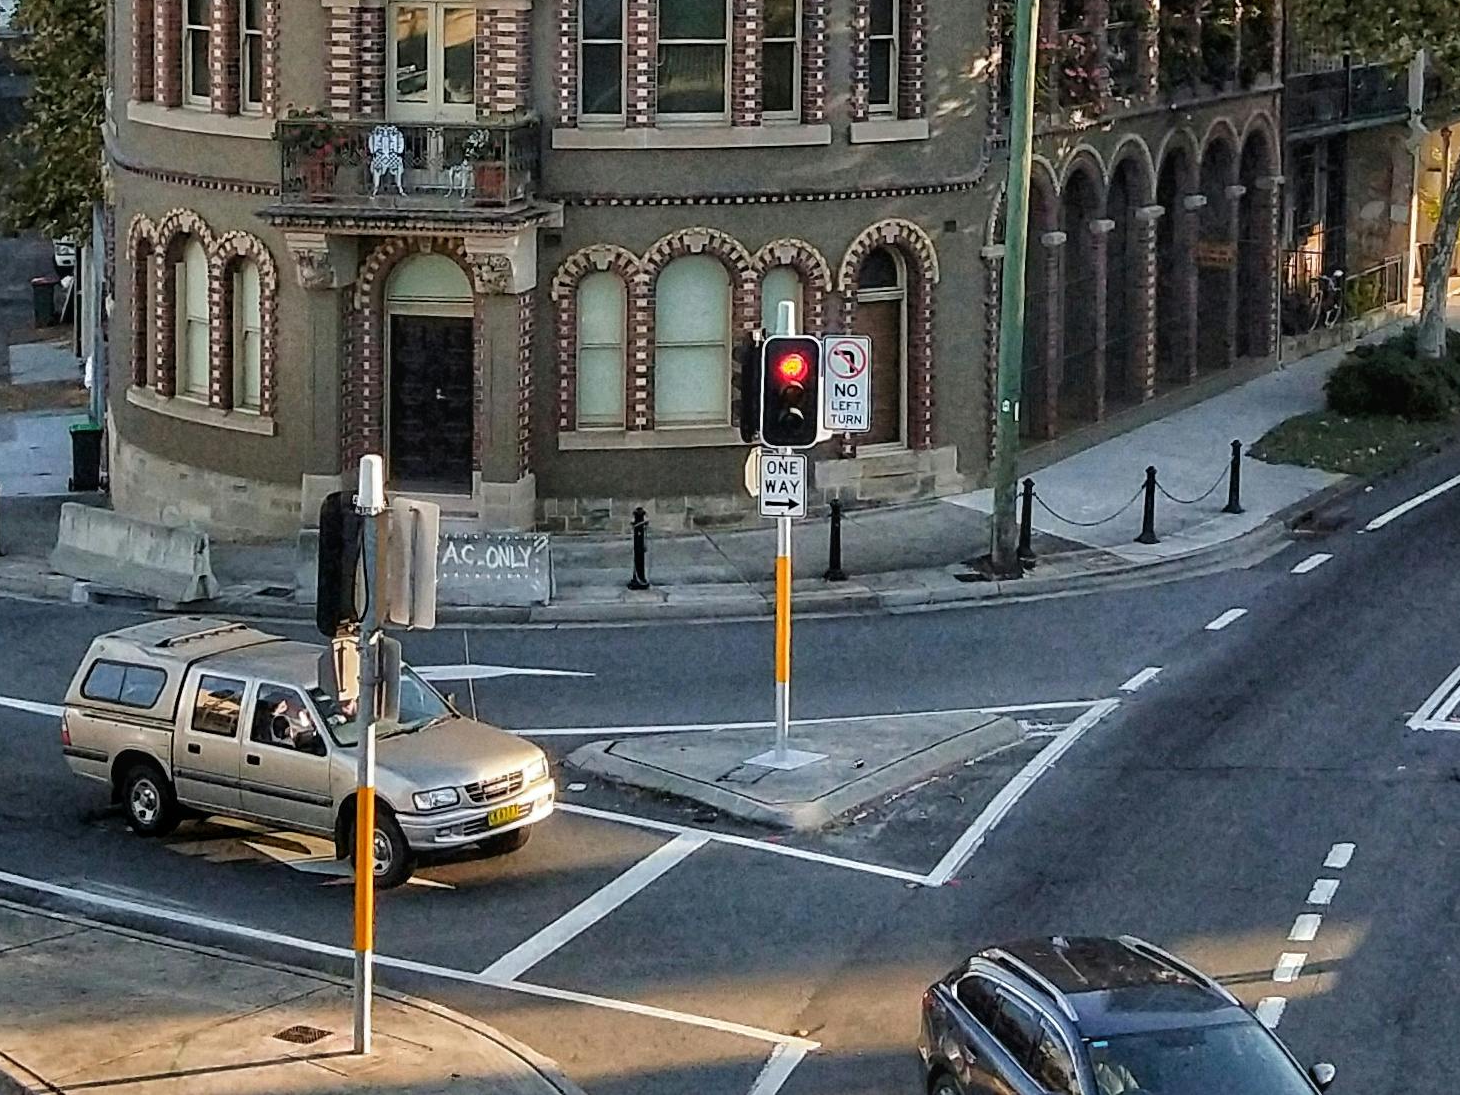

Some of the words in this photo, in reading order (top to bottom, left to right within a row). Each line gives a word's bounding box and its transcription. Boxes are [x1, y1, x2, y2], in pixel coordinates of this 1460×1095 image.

[834, 383, 858, 398] NO
[831, 400, 861, 411] LEFT
[831, 414, 862, 425] TURN
[766, 460, 798, 475] ONE
[765, 479, 800, 494] WAY
[486, 545, 532, 569] ONLY
